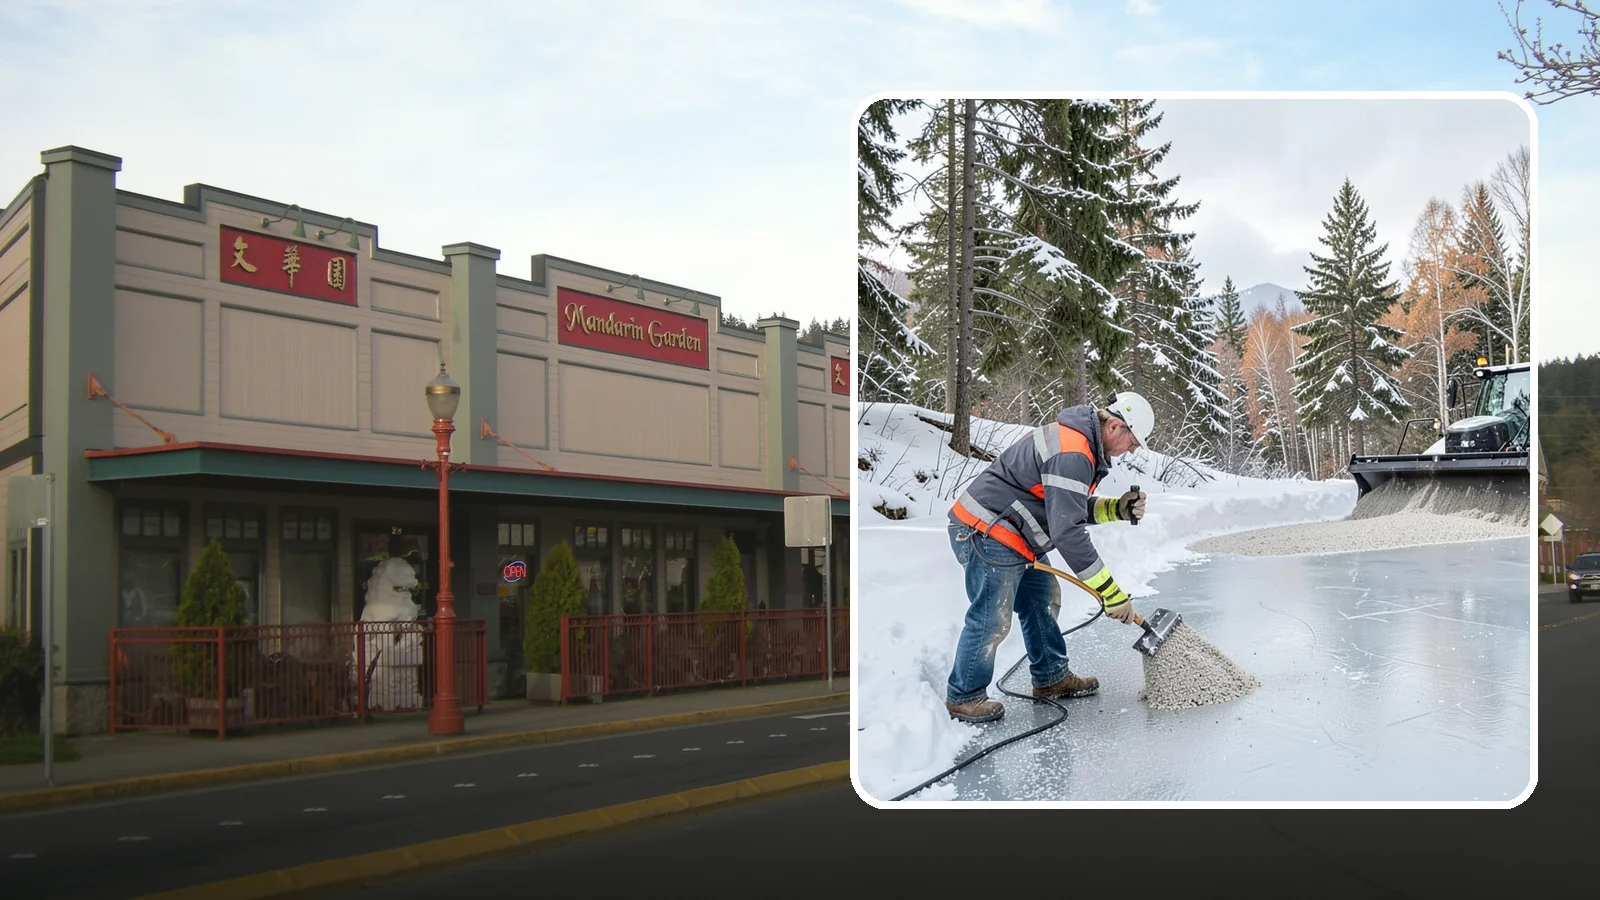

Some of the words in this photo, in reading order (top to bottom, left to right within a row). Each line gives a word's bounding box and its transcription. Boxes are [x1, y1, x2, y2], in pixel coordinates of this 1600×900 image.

[231, 235, 346, 291] 文華園
[564, 302, 644, 341] Mandarin
[648, 320, 701, 352] Garden
[503, 564, 527, 578] OPEN
